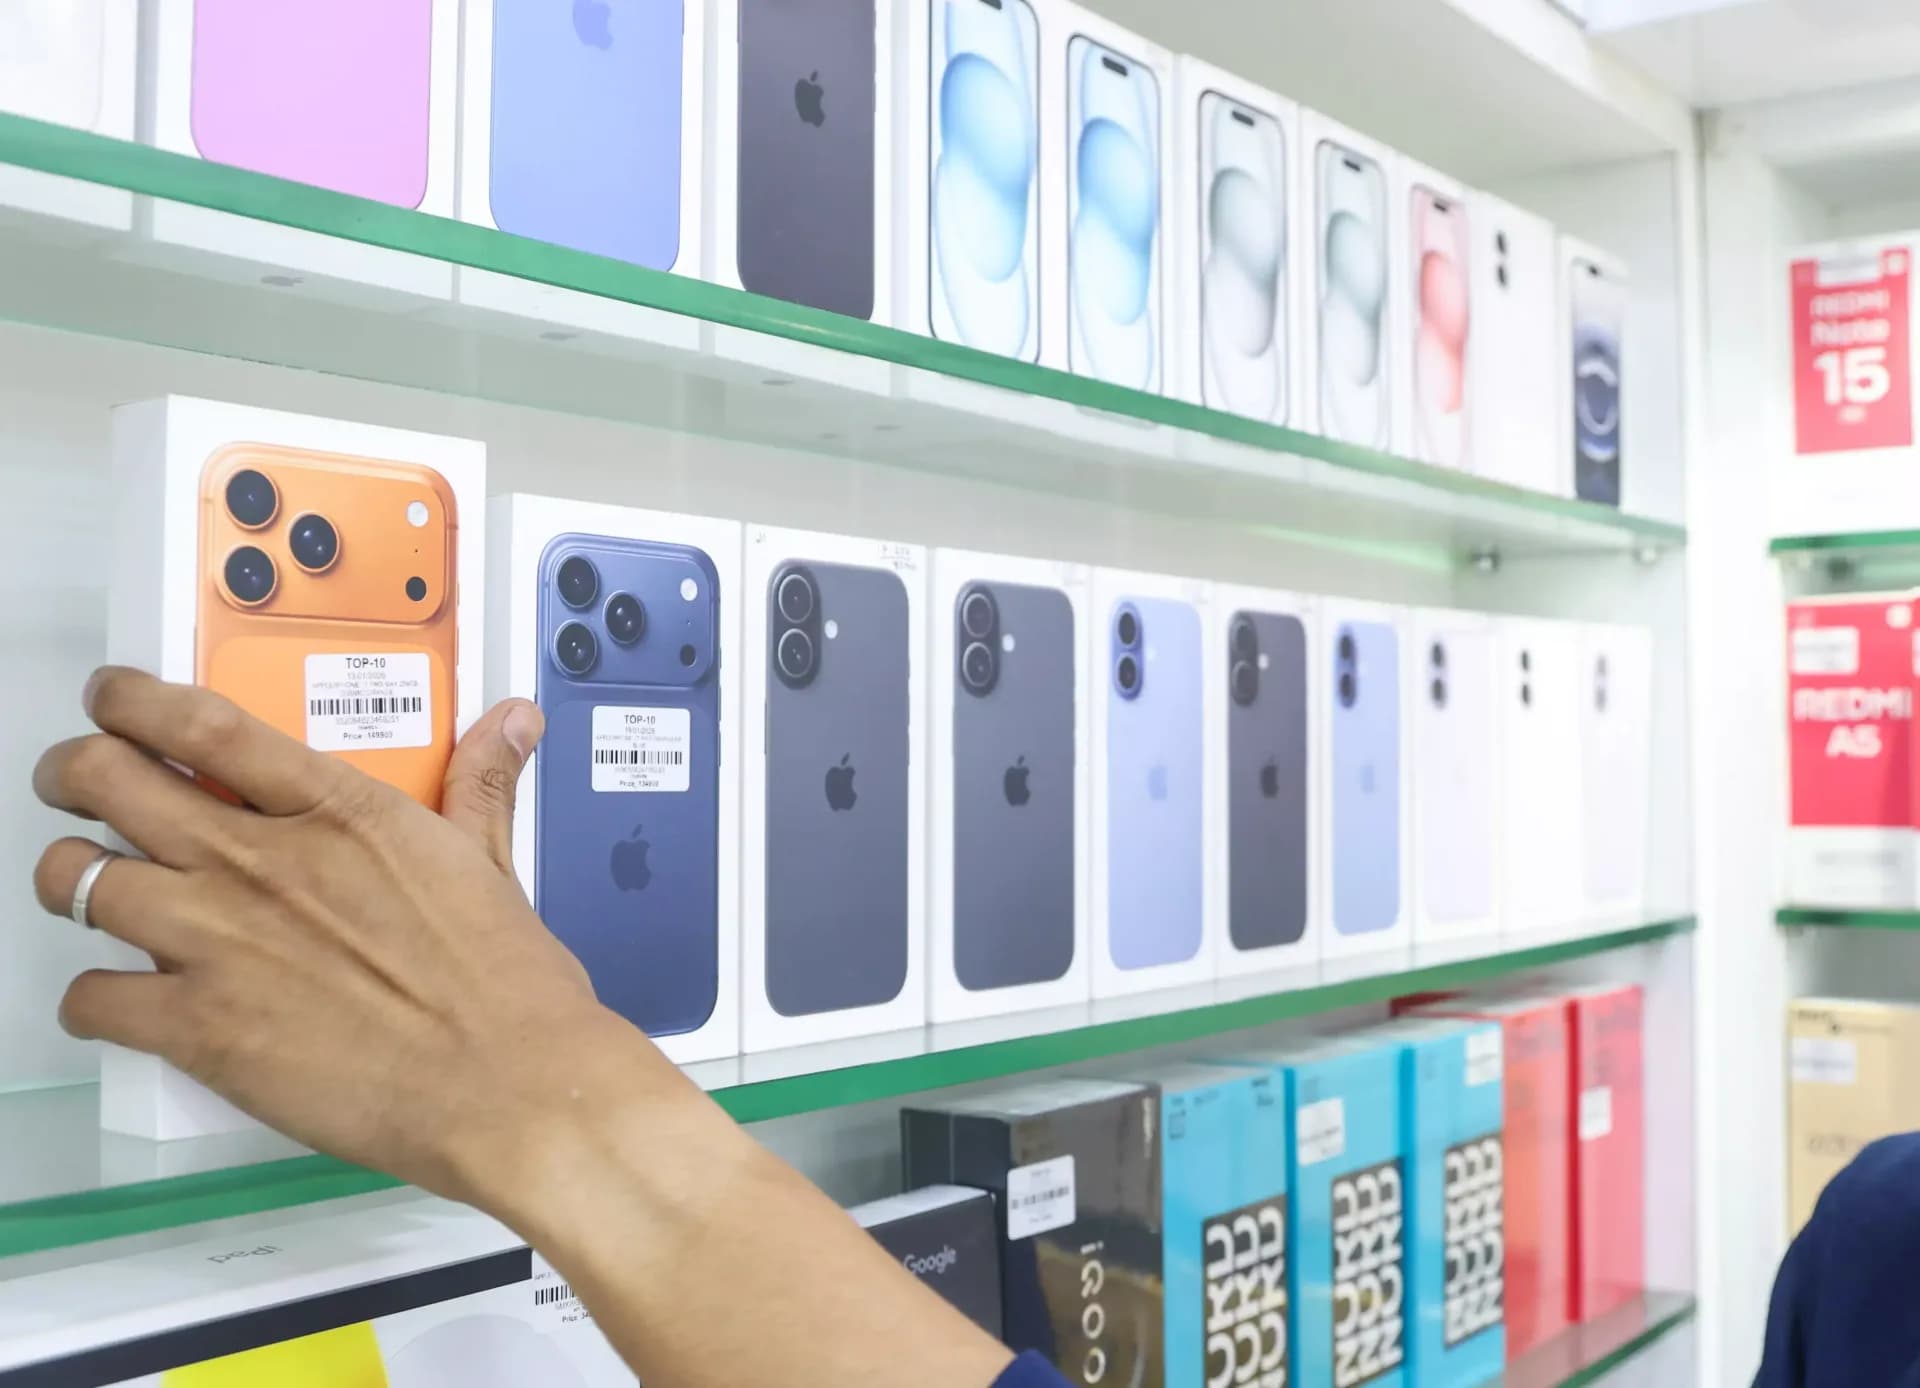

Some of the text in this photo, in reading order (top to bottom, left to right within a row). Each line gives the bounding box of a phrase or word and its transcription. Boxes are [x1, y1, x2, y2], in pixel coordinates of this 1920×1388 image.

[1810, 316, 1891, 346] Note
[1812, 346, 1891, 406] 15
[345, 657, 386, 669] TOP-10
[1793, 687, 1913, 721] REDMI
[624, 714, 656, 725] TOP-10
[206, 1245, 284, 1264] iPad
[904, 1246, 957, 1275] Google
[1080, 1241, 1106, 1385] iQOO
